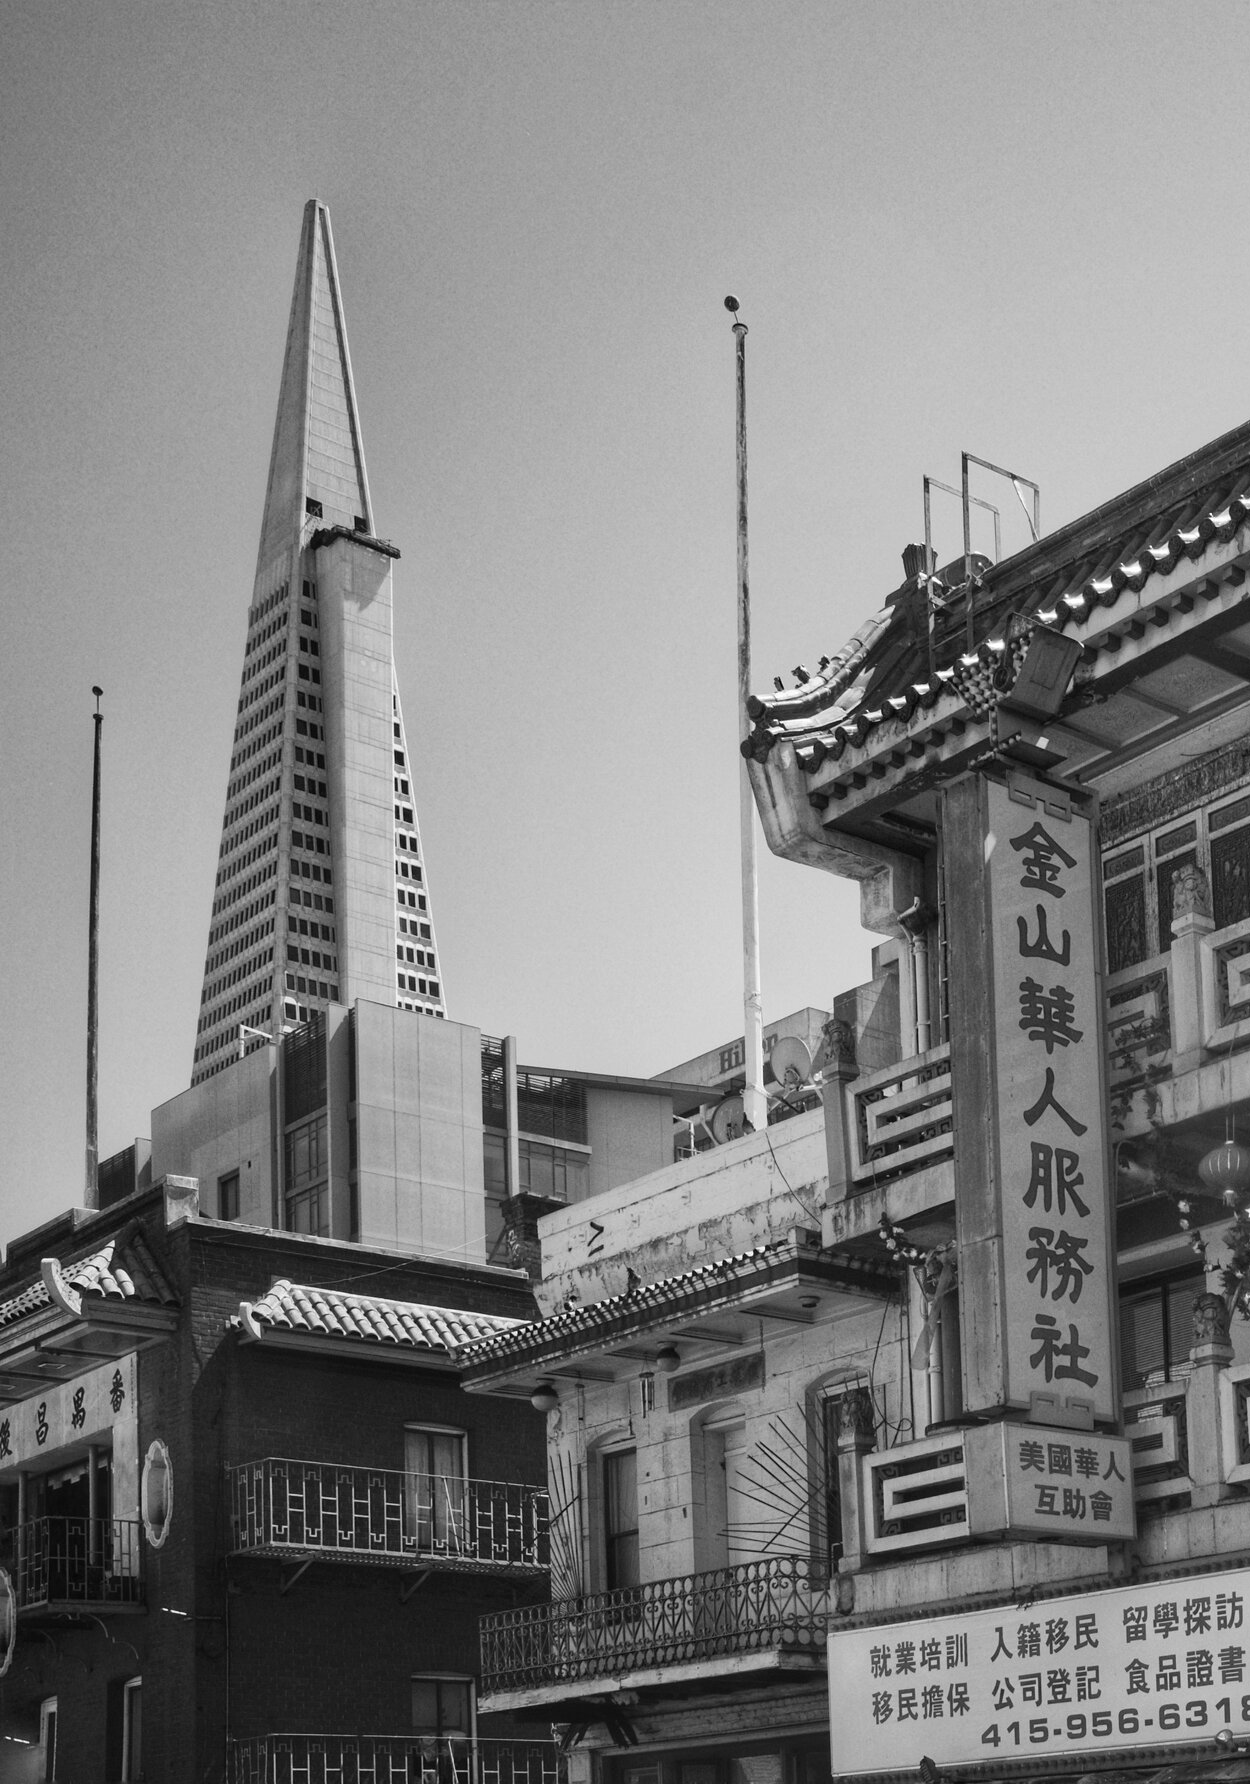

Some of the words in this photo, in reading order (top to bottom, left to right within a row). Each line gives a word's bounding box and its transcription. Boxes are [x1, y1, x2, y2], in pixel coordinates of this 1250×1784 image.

[719, 1034, 778, 1074] Hiln
[1009, 821, 1099, 1389] 金山華人服務社
[1019, 1440, 1126, 1482] 美國華人
[1035, 1484, 1112, 1521] 互助會
[870, 1633, 968, 1678] 就業培訓
[990, 1613, 1099, 1662] 入籍移民
[1123, 1591, 1244, 1643] 留學探訪
[872, 1682, 970, 1725] 移民擔保
[992, 1665, 1101, 1711] 公司登記
[1125, 1646, 1246, 1695] 食品證書
